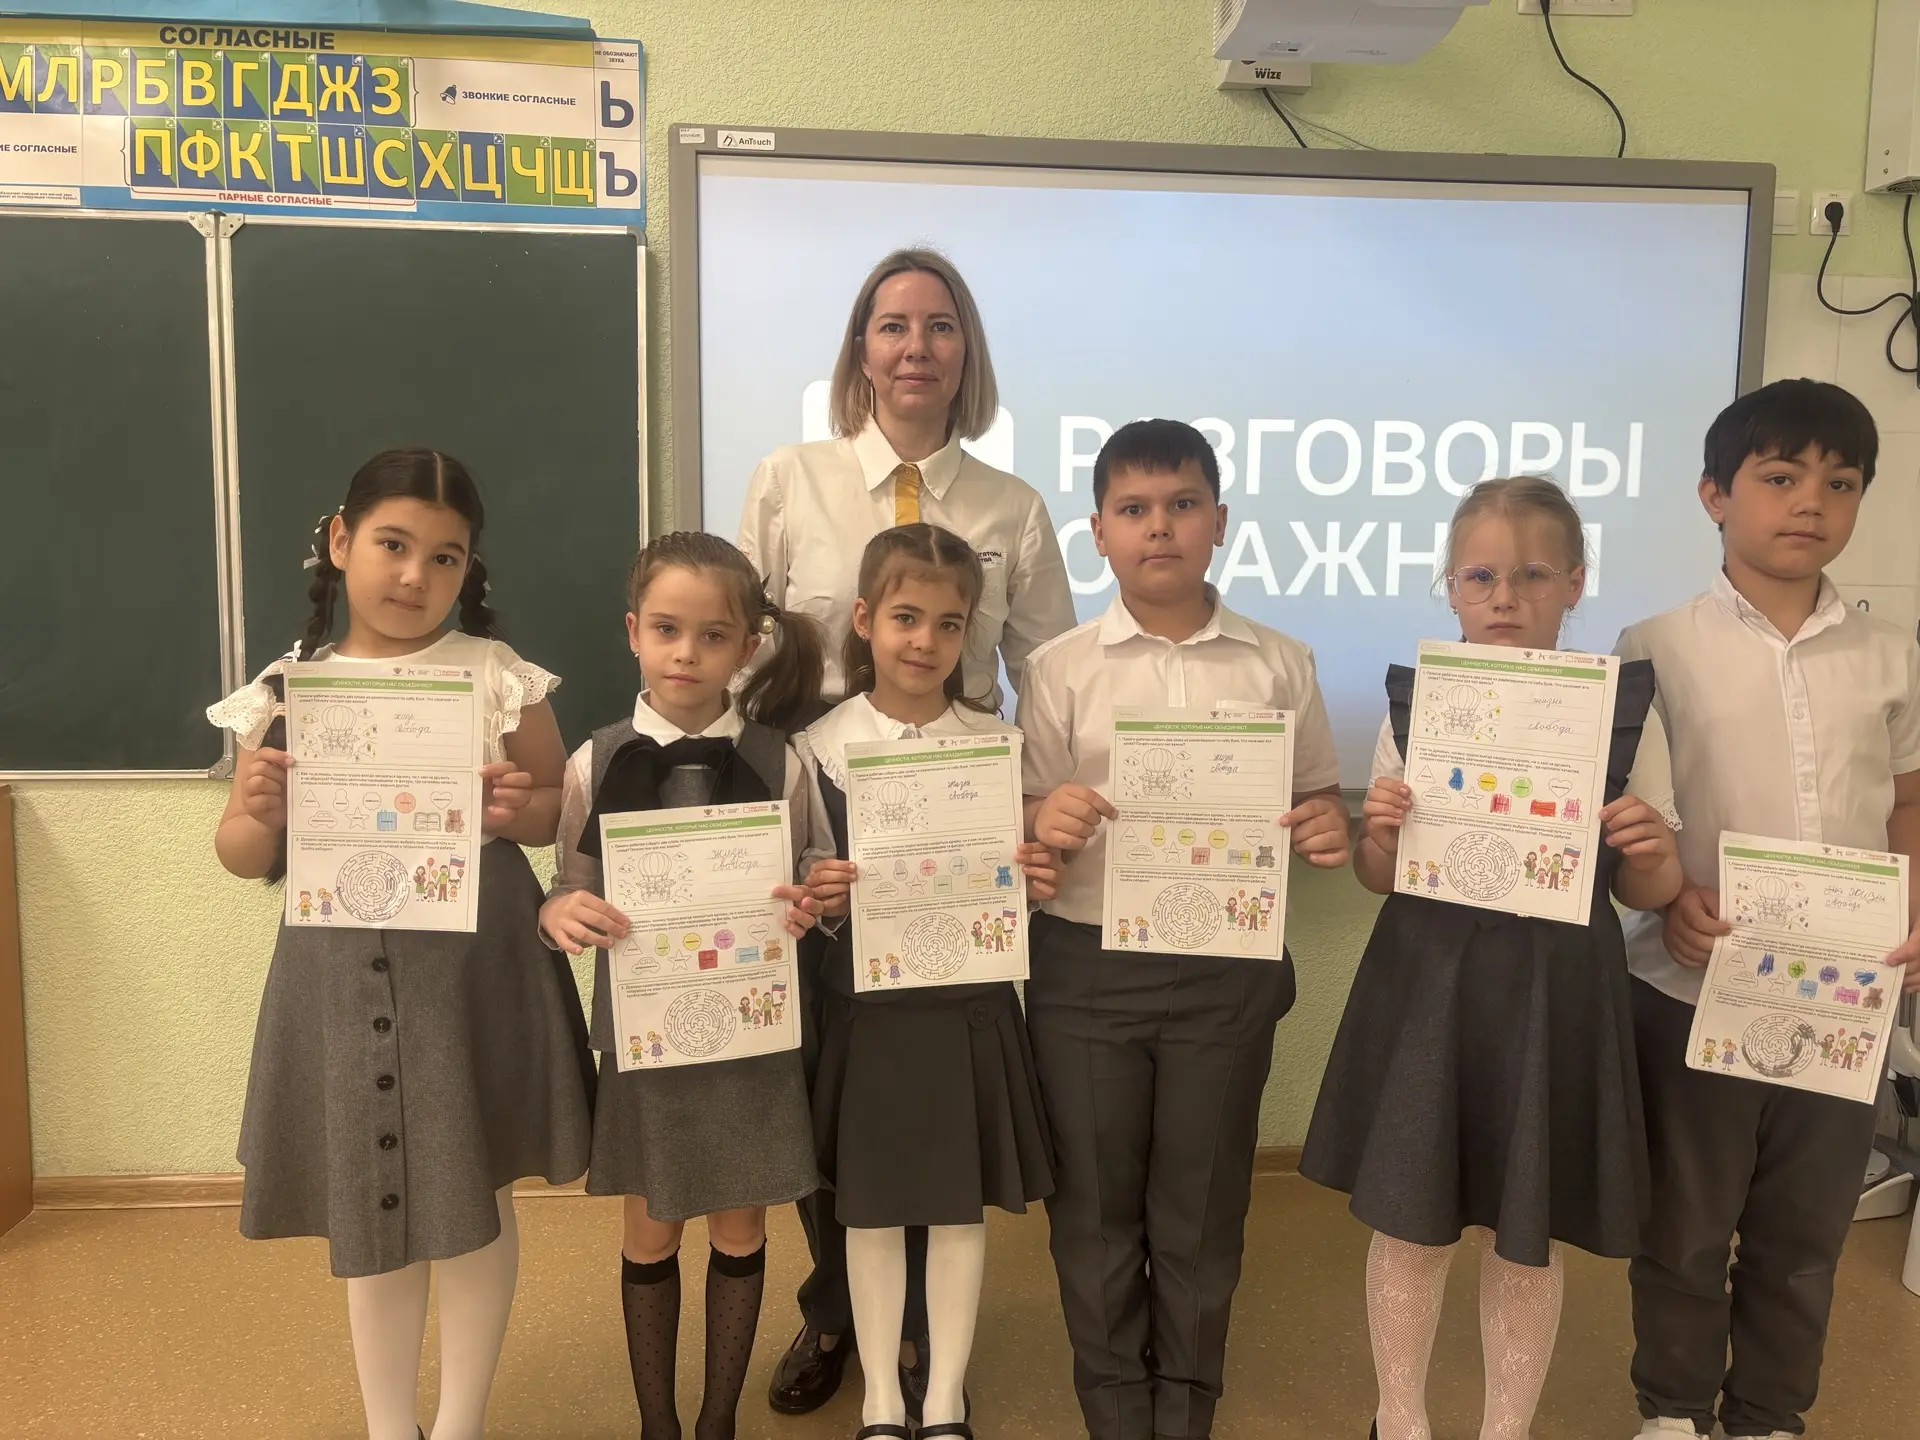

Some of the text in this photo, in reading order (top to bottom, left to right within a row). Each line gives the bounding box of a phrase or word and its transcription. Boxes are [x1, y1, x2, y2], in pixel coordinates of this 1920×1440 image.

[159, 25, 334, 50] СОГЛАСНЫЕ
[0, 56, 404, 117] М Л Р Б В Г Д Ж З
[462, 91, 577, 106] ЗВОНКИЕ СОГЛАСНЫЕ
[600, 80, 636, 130] Ь
[13, 144, 78, 154] СОГЛАСНЫЕ
[135, 128, 596, 203] П Ф К Т Ш С Х Ц Ч Щ
[218, 192, 333, 205] ПАРНЫЕ СОГЛАСНЫЕ
[598, 151, 638, 199] Ъ
[1059, 414, 1644, 498] РЗГОВОРЫ
